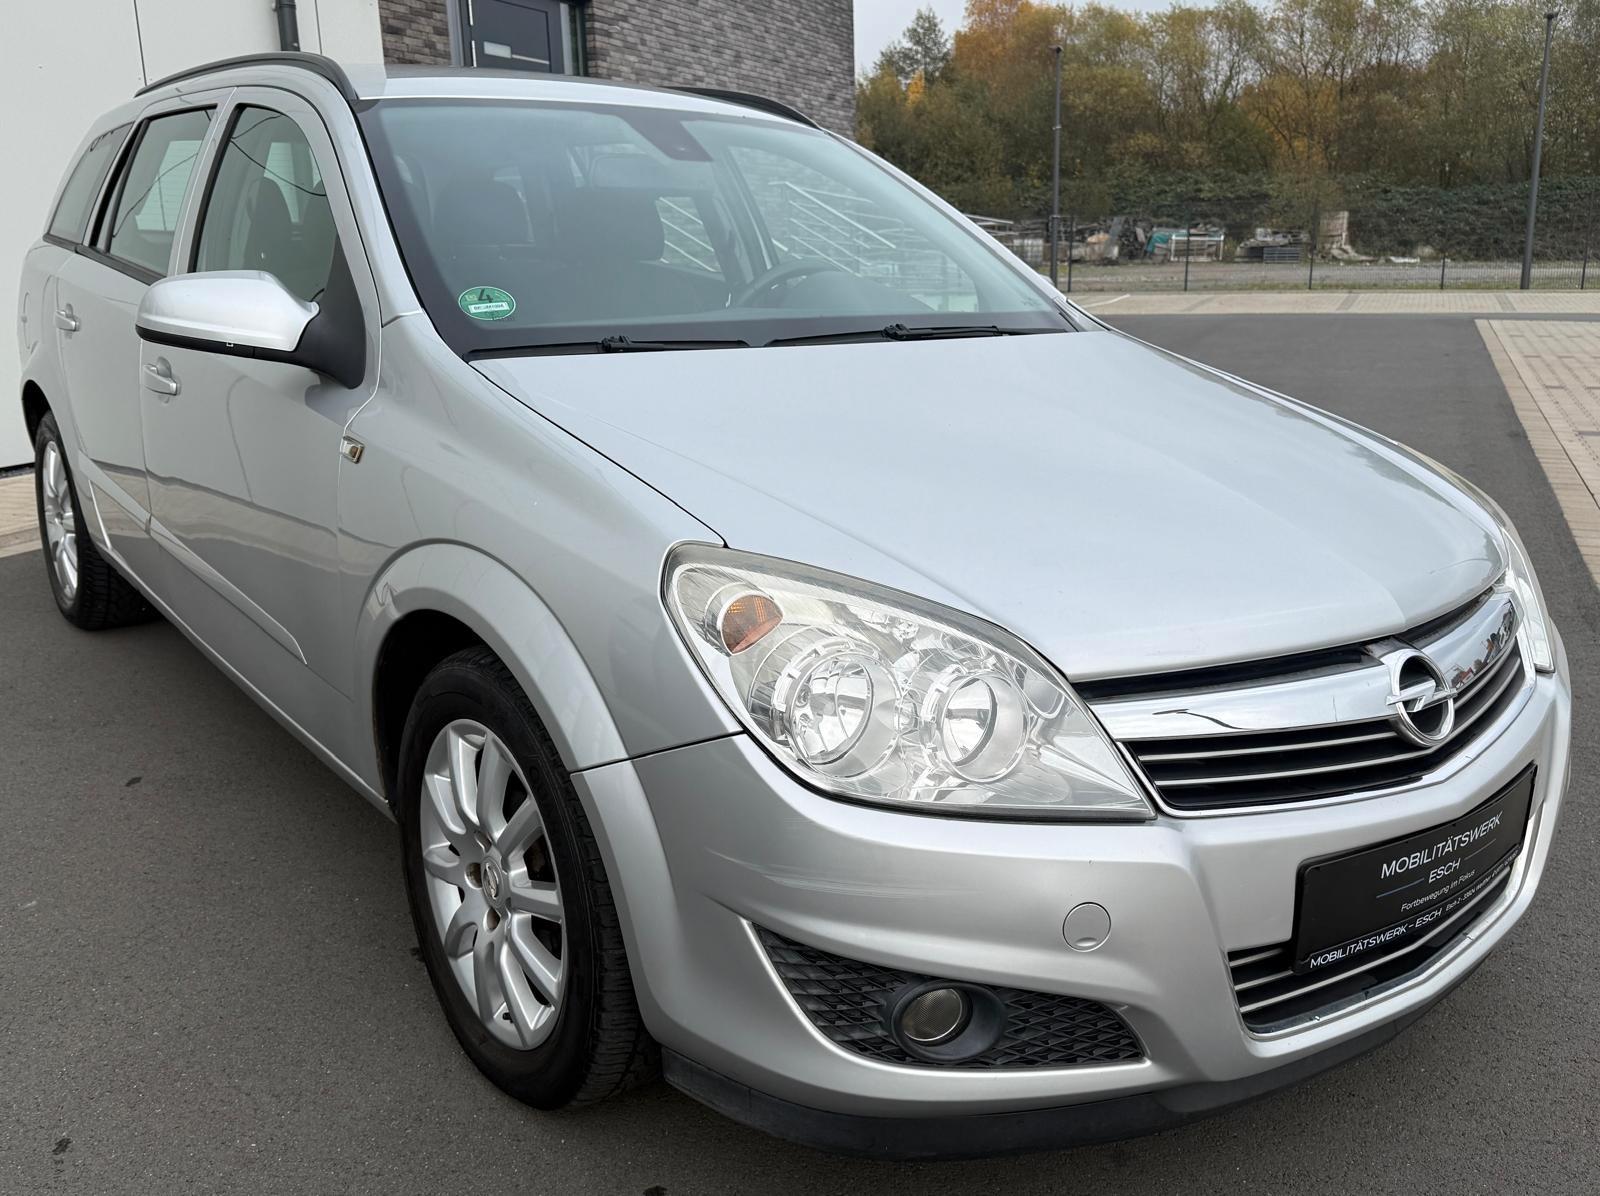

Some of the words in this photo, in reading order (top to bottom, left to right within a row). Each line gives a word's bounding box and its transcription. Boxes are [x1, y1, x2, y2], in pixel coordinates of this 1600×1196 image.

[478, 288, 493, 303] 4
[1381, 811, 1503, 879] MOBILITÄTSWERK
[1401, 884, 1449, 912] Fortbewegung
[1459, 869, 1475, 884] Fokus
[1428, 859, 1461, 884] ESCH
[1310, 924, 1407, 968] MOBILITÄTSWERK
[1415, 908, 1442, 928] ESCH
